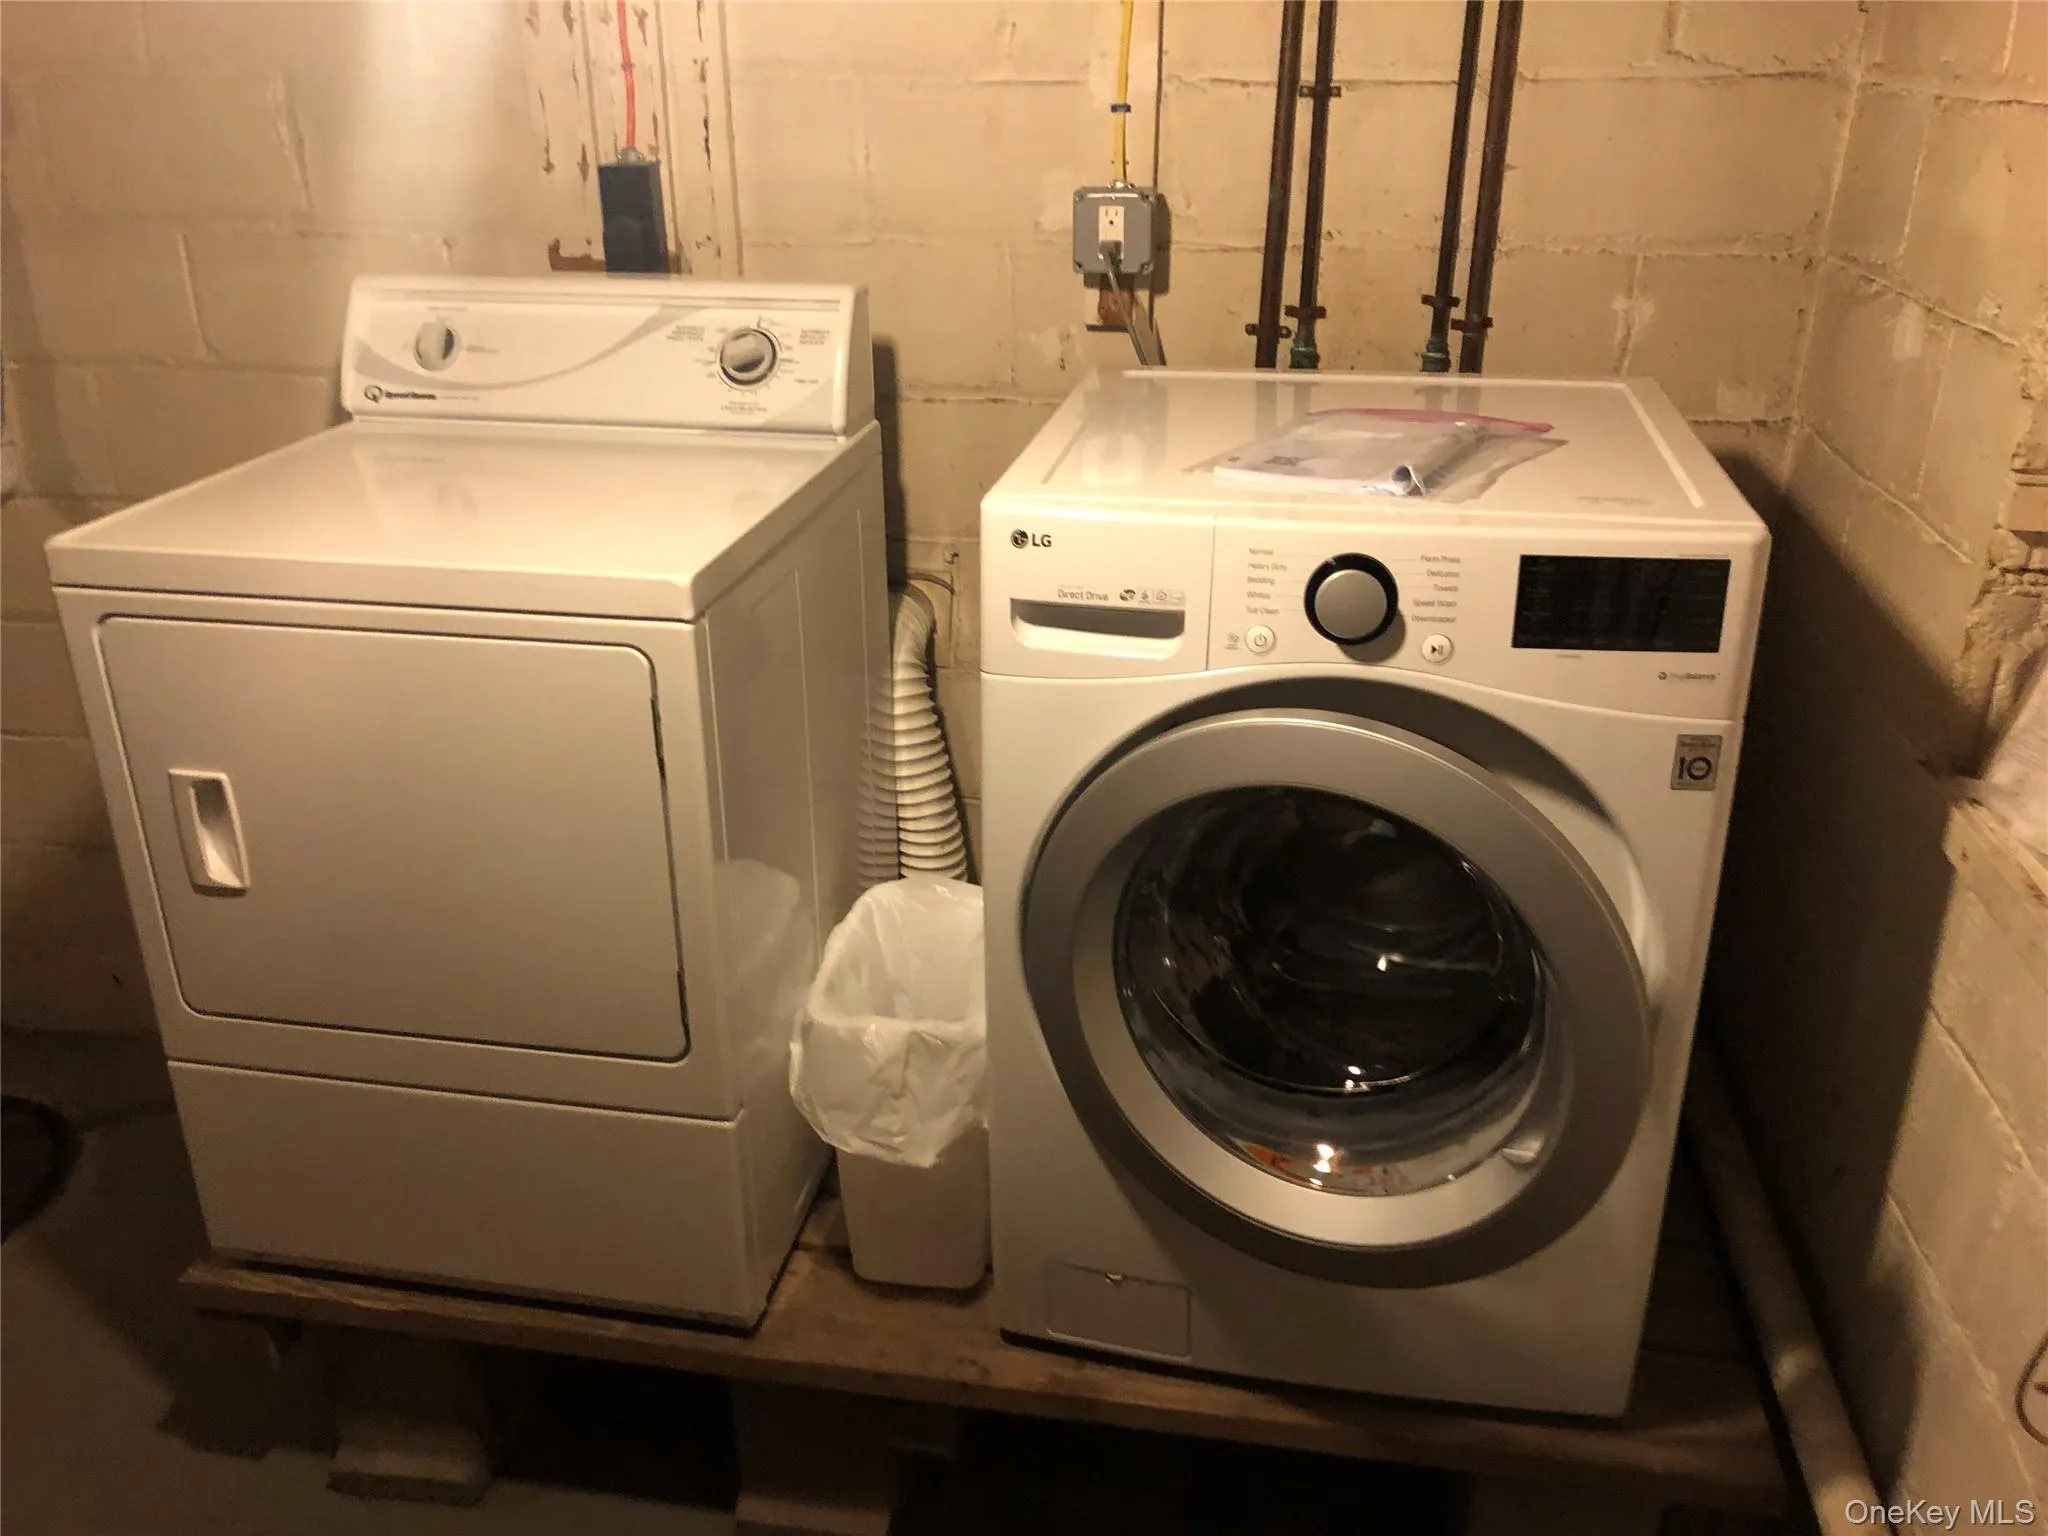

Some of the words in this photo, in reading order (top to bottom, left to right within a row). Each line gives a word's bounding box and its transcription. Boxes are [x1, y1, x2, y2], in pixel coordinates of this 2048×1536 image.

[1031, 533, 1052, 548] LG
[1057, 588, 1084, 601] Direct
[1085, 590, 1109, 602] Drive
